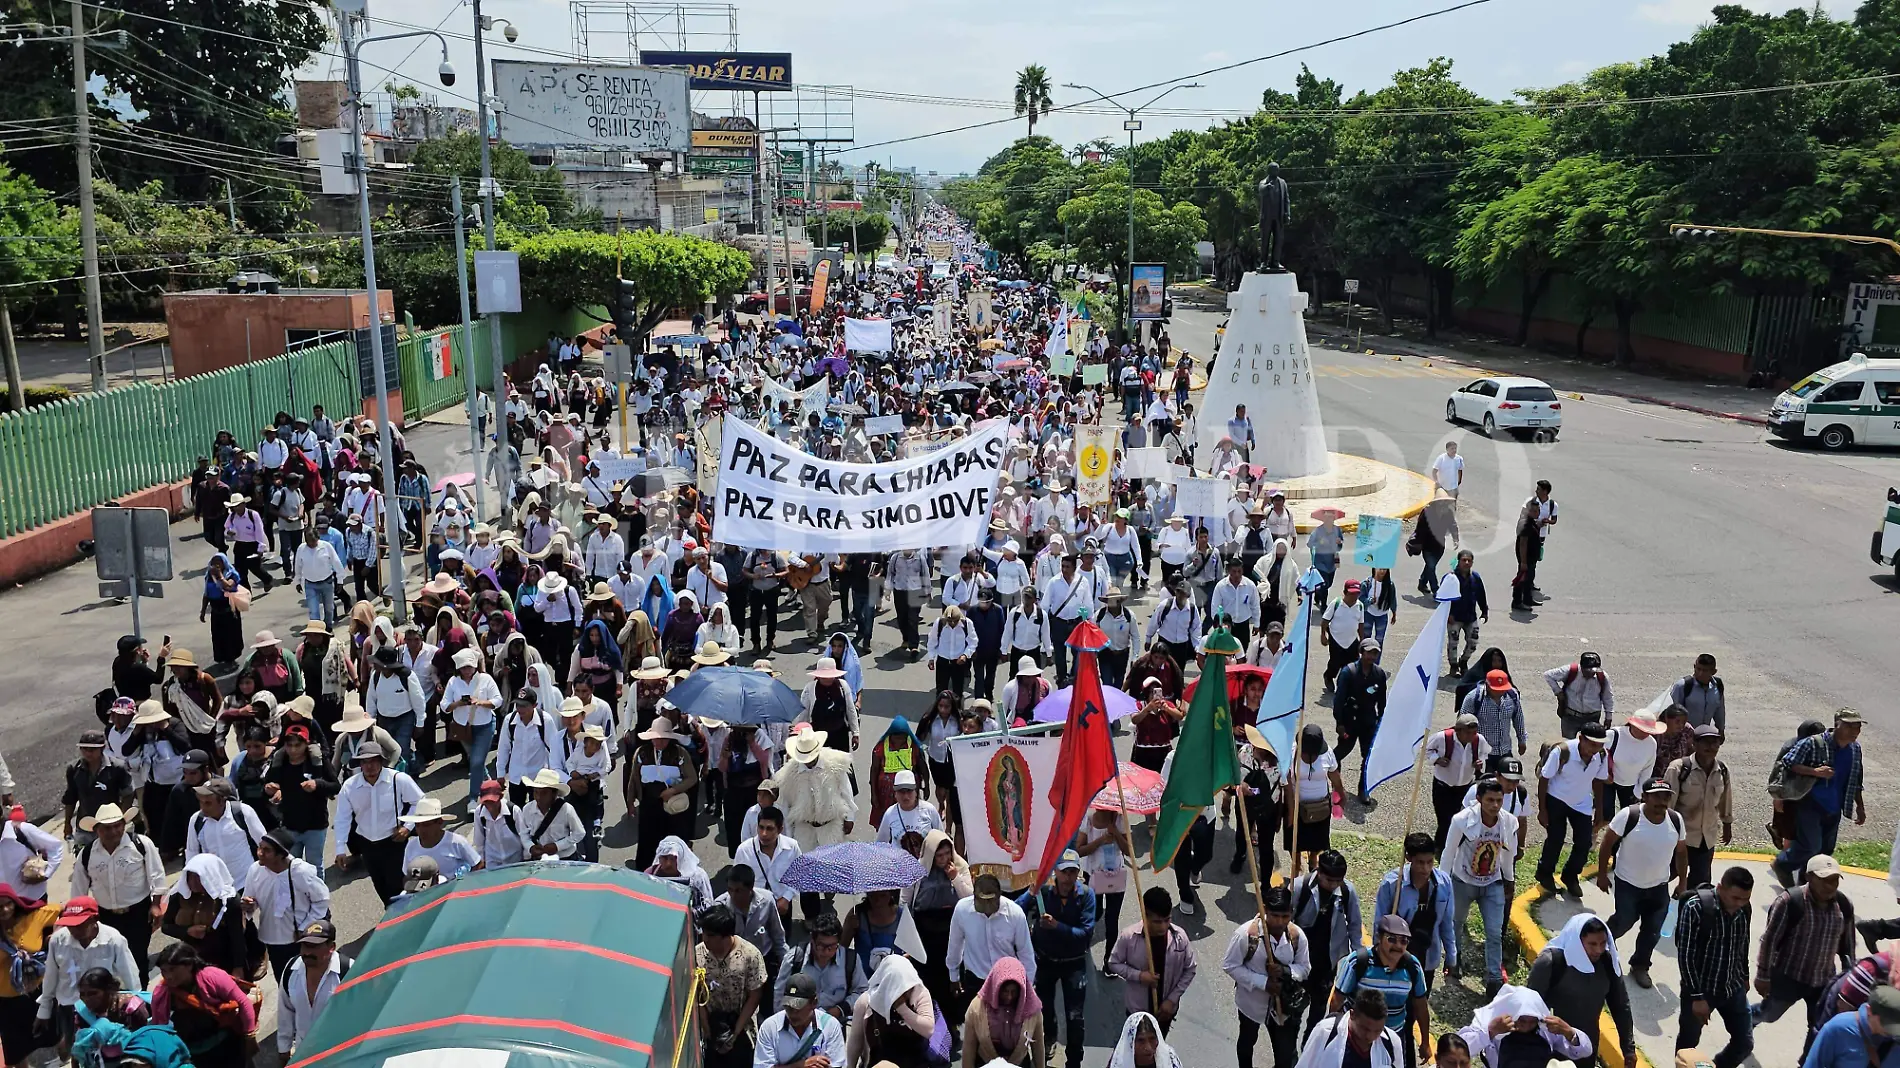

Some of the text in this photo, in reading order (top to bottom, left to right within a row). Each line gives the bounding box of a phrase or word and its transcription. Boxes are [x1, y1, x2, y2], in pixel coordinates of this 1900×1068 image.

[576, 72, 654, 98] SE RENTA
[1236, 342, 1308, 355] ANGEL
[1233, 357, 1309, 371] ALBINO
[1231, 371, 1311, 386] CORZO
[729, 437, 790, 484] PAZ
[798, 460, 881, 497] PARA
[890, 436, 1004, 493] CHIAPAS
[724, 486, 775, 521] PAZ
[782, 501, 853, 531] PARA
